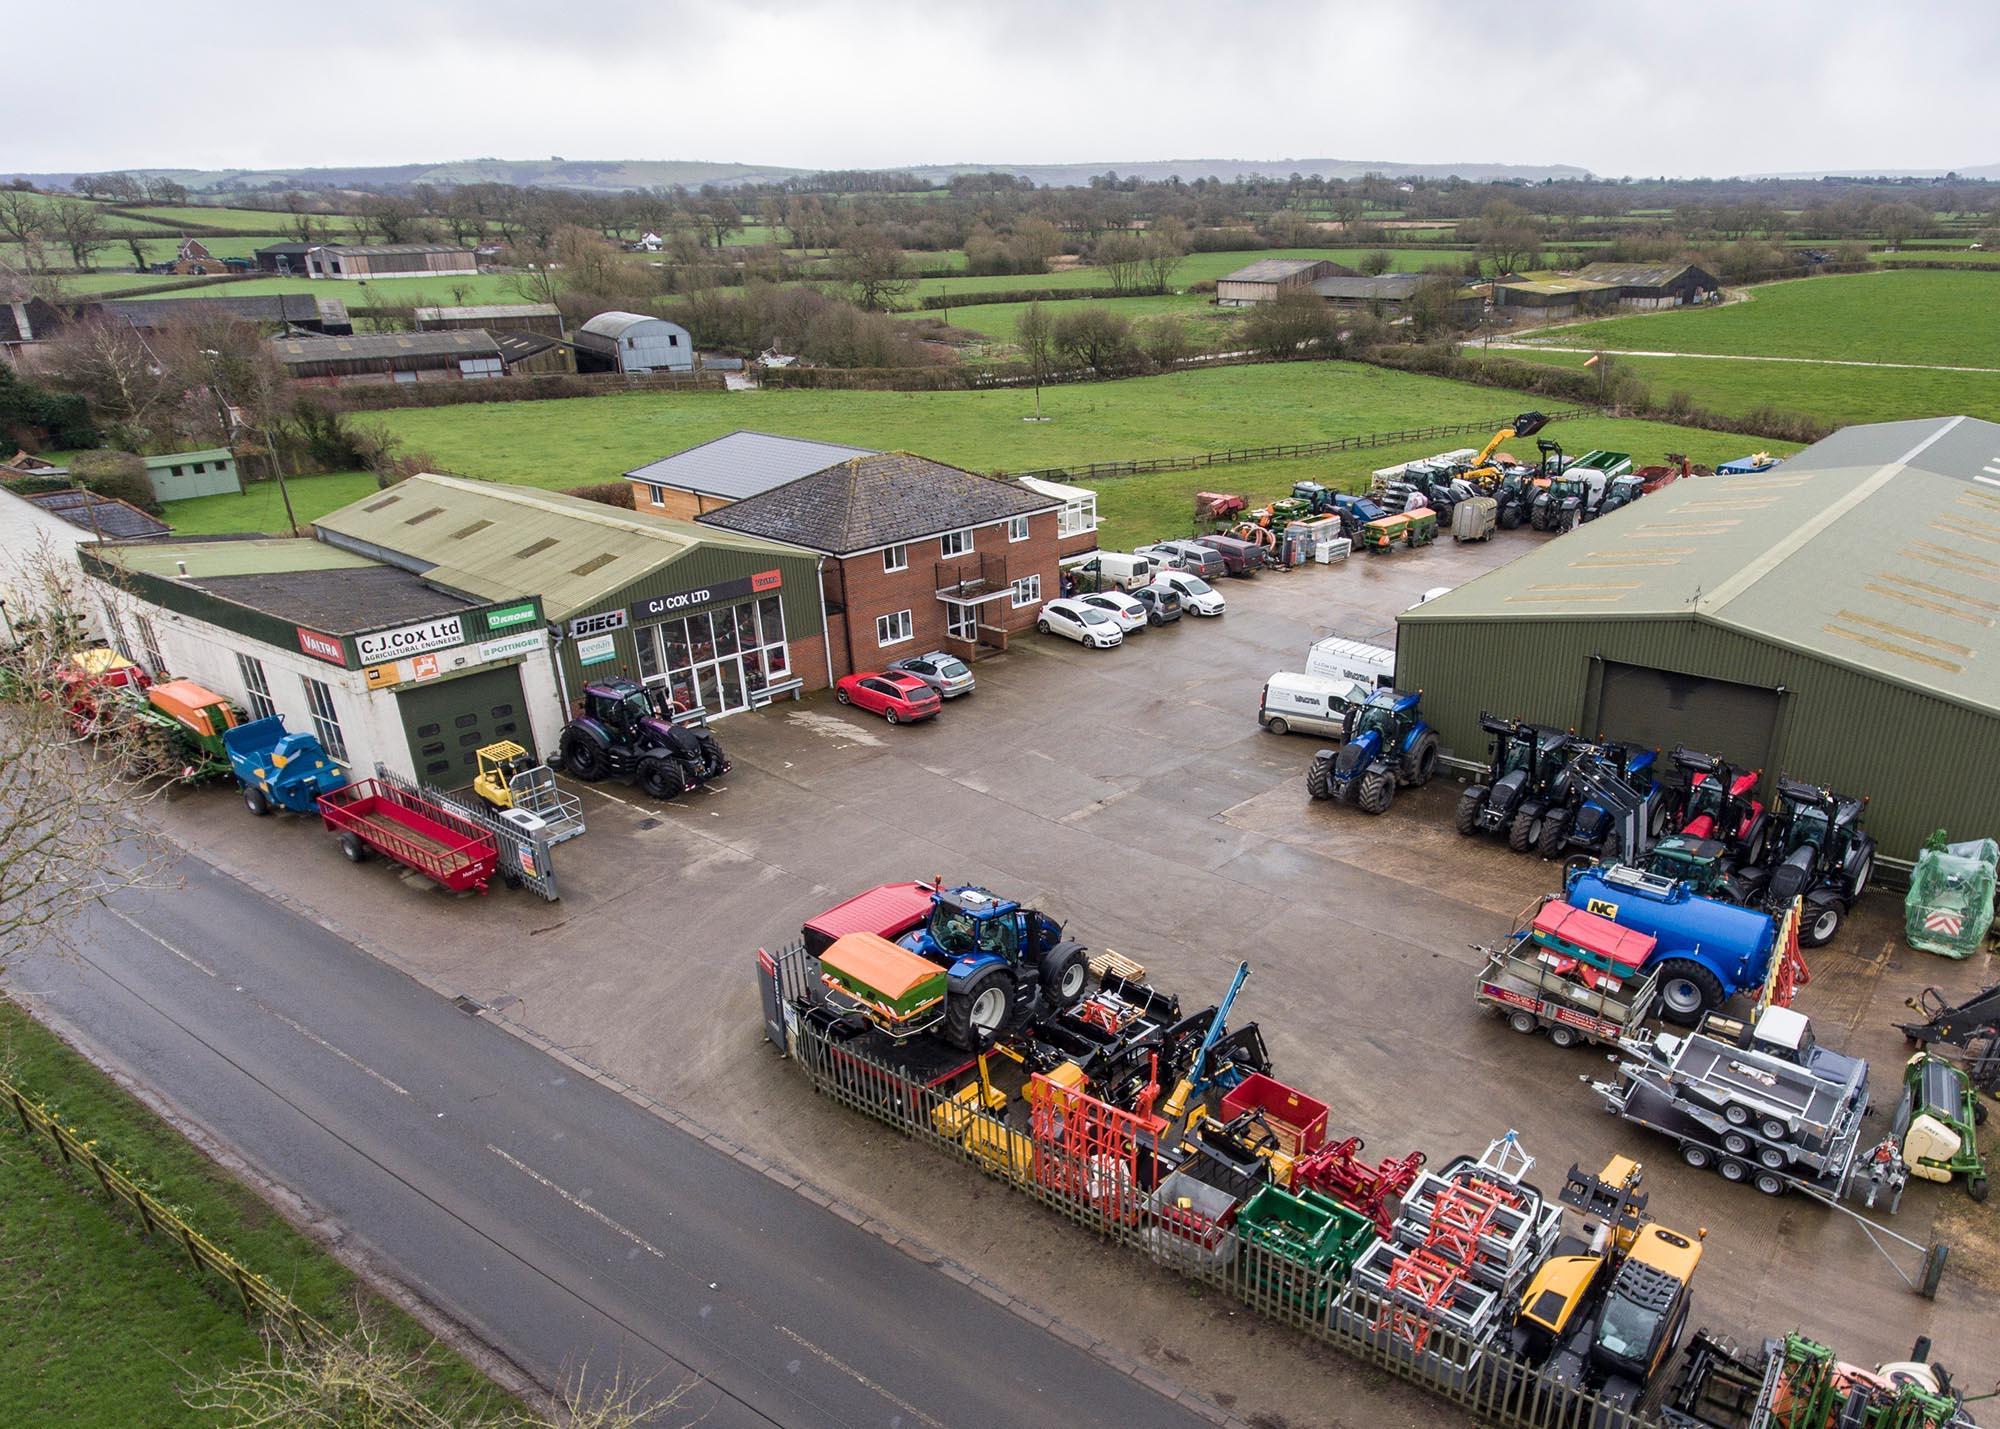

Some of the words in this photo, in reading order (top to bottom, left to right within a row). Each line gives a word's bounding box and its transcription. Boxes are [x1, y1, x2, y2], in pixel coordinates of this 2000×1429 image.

[649, 600, 664, 613] CJ
[666, 594, 690, 609] COX
[691, 589, 710, 603] LTD
[431, 620, 460, 638] Ltd
[302, 634, 339, 658] VALTRA
[364, 645, 420, 662] AGRICULTURAL
[421, 635, 462, 648] ENGINEERS
[1590, 901, 1615, 916] NC
